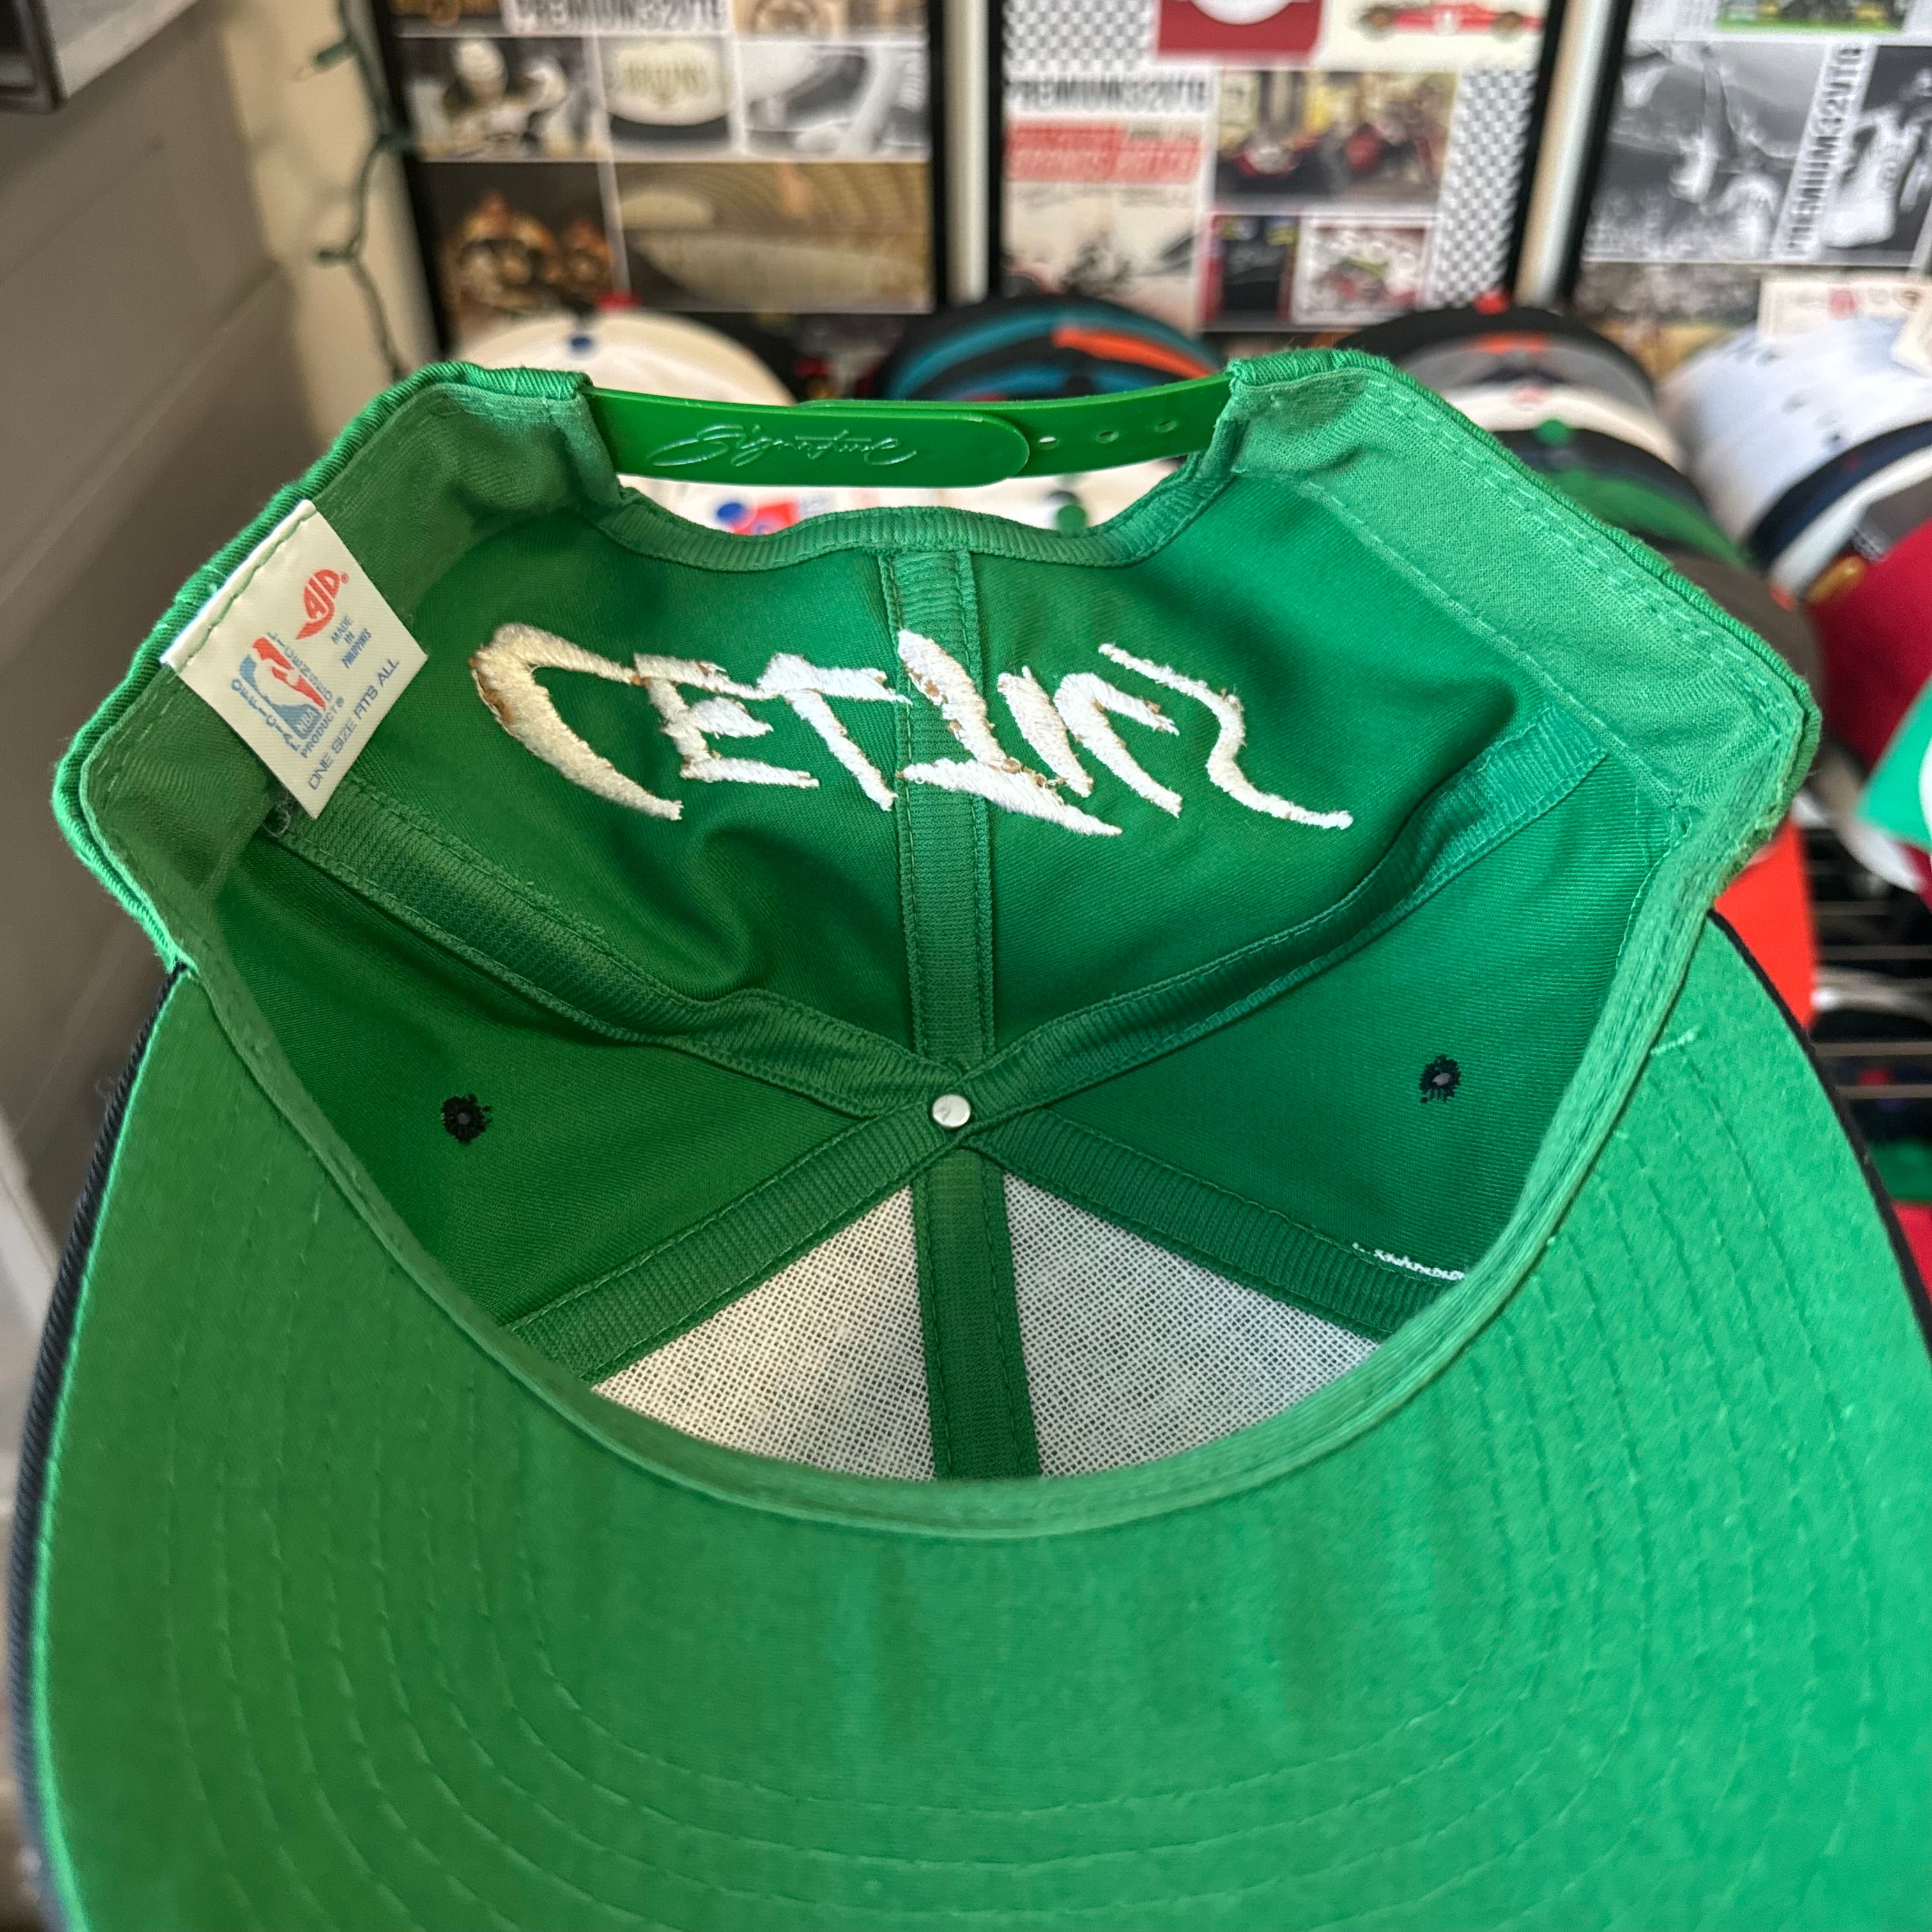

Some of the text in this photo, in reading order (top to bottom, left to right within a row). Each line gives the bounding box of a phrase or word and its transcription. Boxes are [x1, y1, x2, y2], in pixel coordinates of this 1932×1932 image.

[646, 424, 917, 467] Signature
[331, 615, 353, 644] MADE
[342, 627, 371, 669] PHILIPPINES
[344, 631, 355, 644] IN
[266, 631, 333, 702] LICENSED
[231, 678, 300, 751] OFFICIAL
[295, 707, 316, 734] NBA
[308, 659, 399, 790] ONE SIZE FITS ALL
